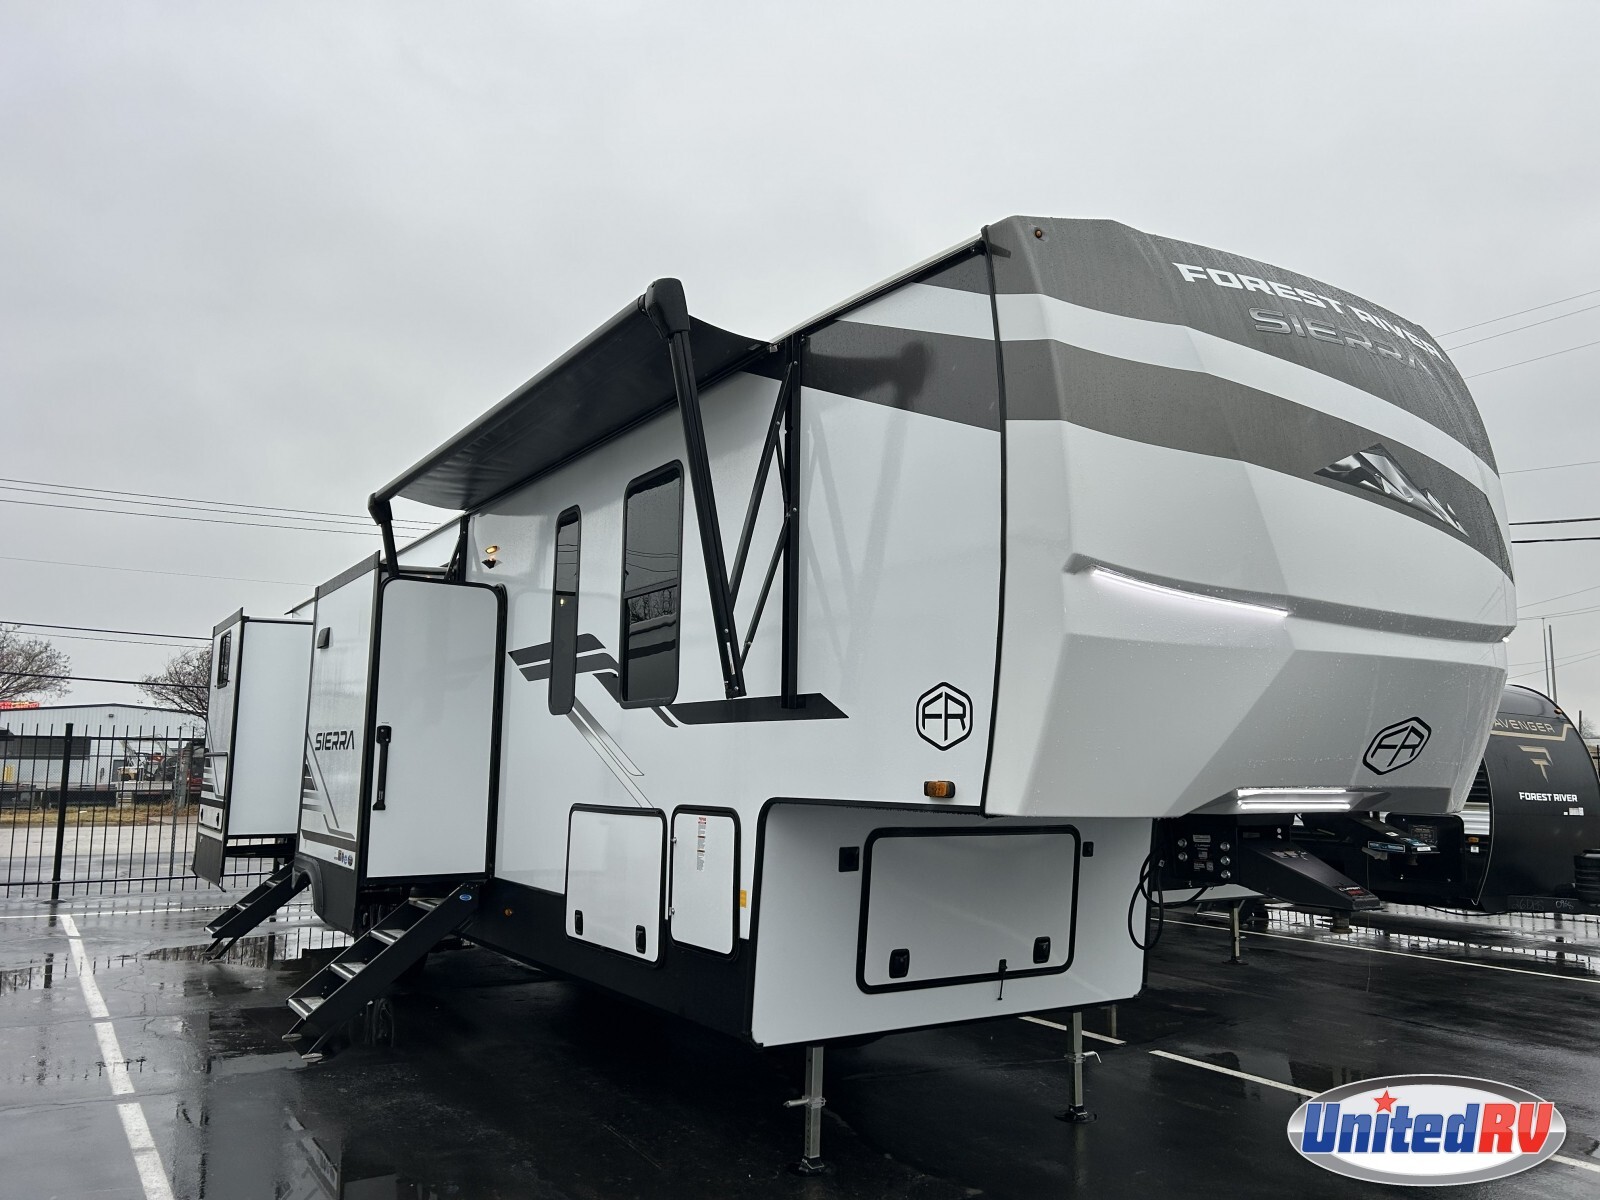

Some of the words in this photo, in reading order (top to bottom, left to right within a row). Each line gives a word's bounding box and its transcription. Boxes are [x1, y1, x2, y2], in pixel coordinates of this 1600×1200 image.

[1172, 262, 1344, 314] FOREST
[1346, 304, 1446, 364] RIVER
[1494, 718, 1556, 734] AVENGER
[314, 730, 355, 751] SIERRA
[1518, 791, 1553, 802] FOREST
[1553, 793, 1578, 803] RIVER
